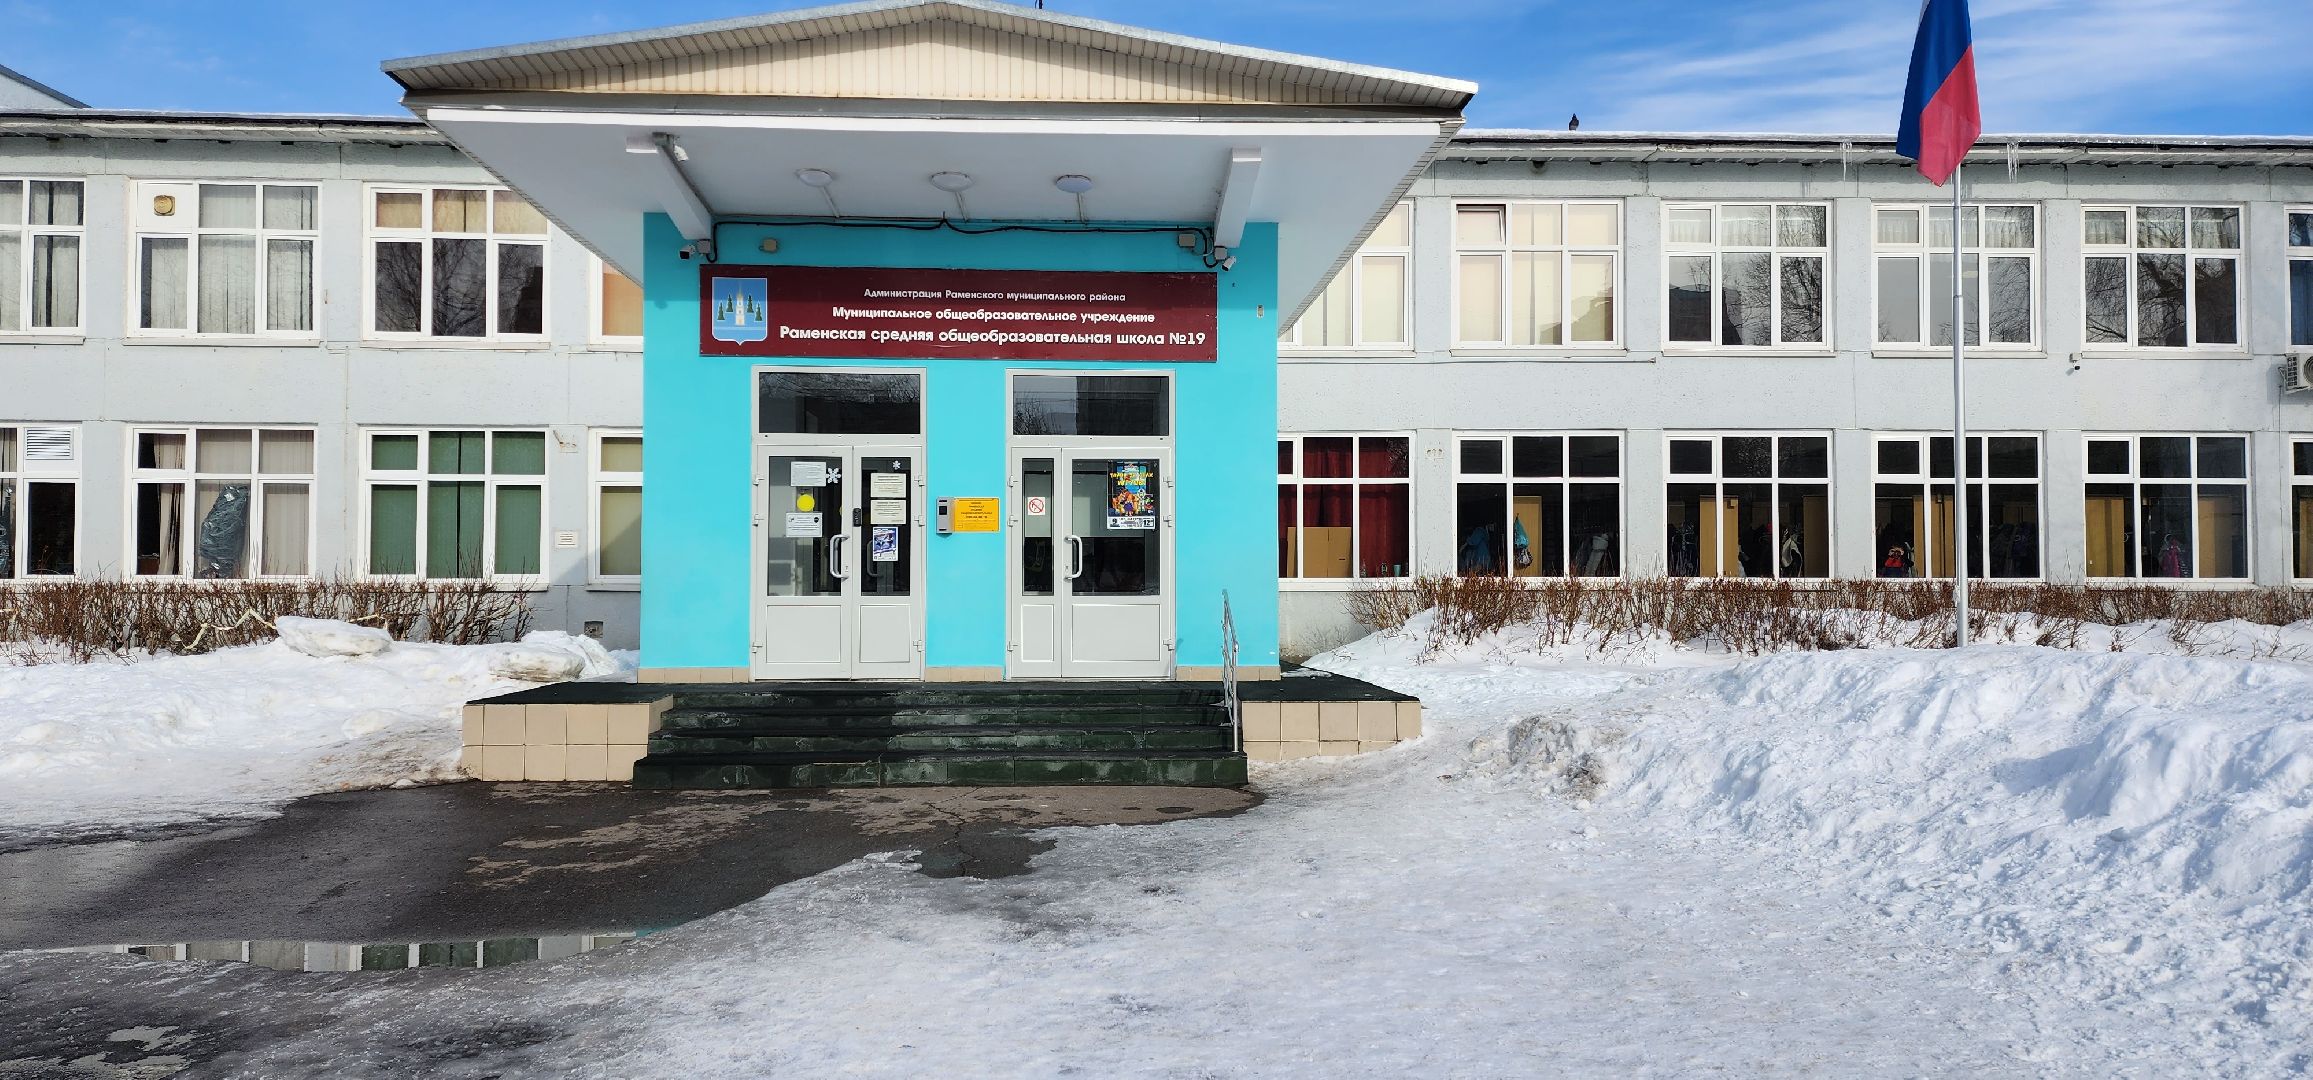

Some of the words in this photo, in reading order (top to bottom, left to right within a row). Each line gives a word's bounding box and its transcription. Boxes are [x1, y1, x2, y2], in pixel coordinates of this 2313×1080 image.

[863, 288, 942, 299] Администрация
[945, 289, 1004, 299] Раменского
[1006, 291, 1087, 302] муниципального
[1089, 293, 1126, 303] района
[832, 306, 933, 320] Муниципальное
[935, 308, 1078, 323] общеобразовательное
[1080, 312, 1156, 324] учреждение
[779, 325, 866, 341] Раменская
[870, 330, 934, 344] средняя
[938, 328, 1112, 346] общеобразовательная
[1116, 334, 1165, 346] школа
[1168, 332, 1206, 346] №19
